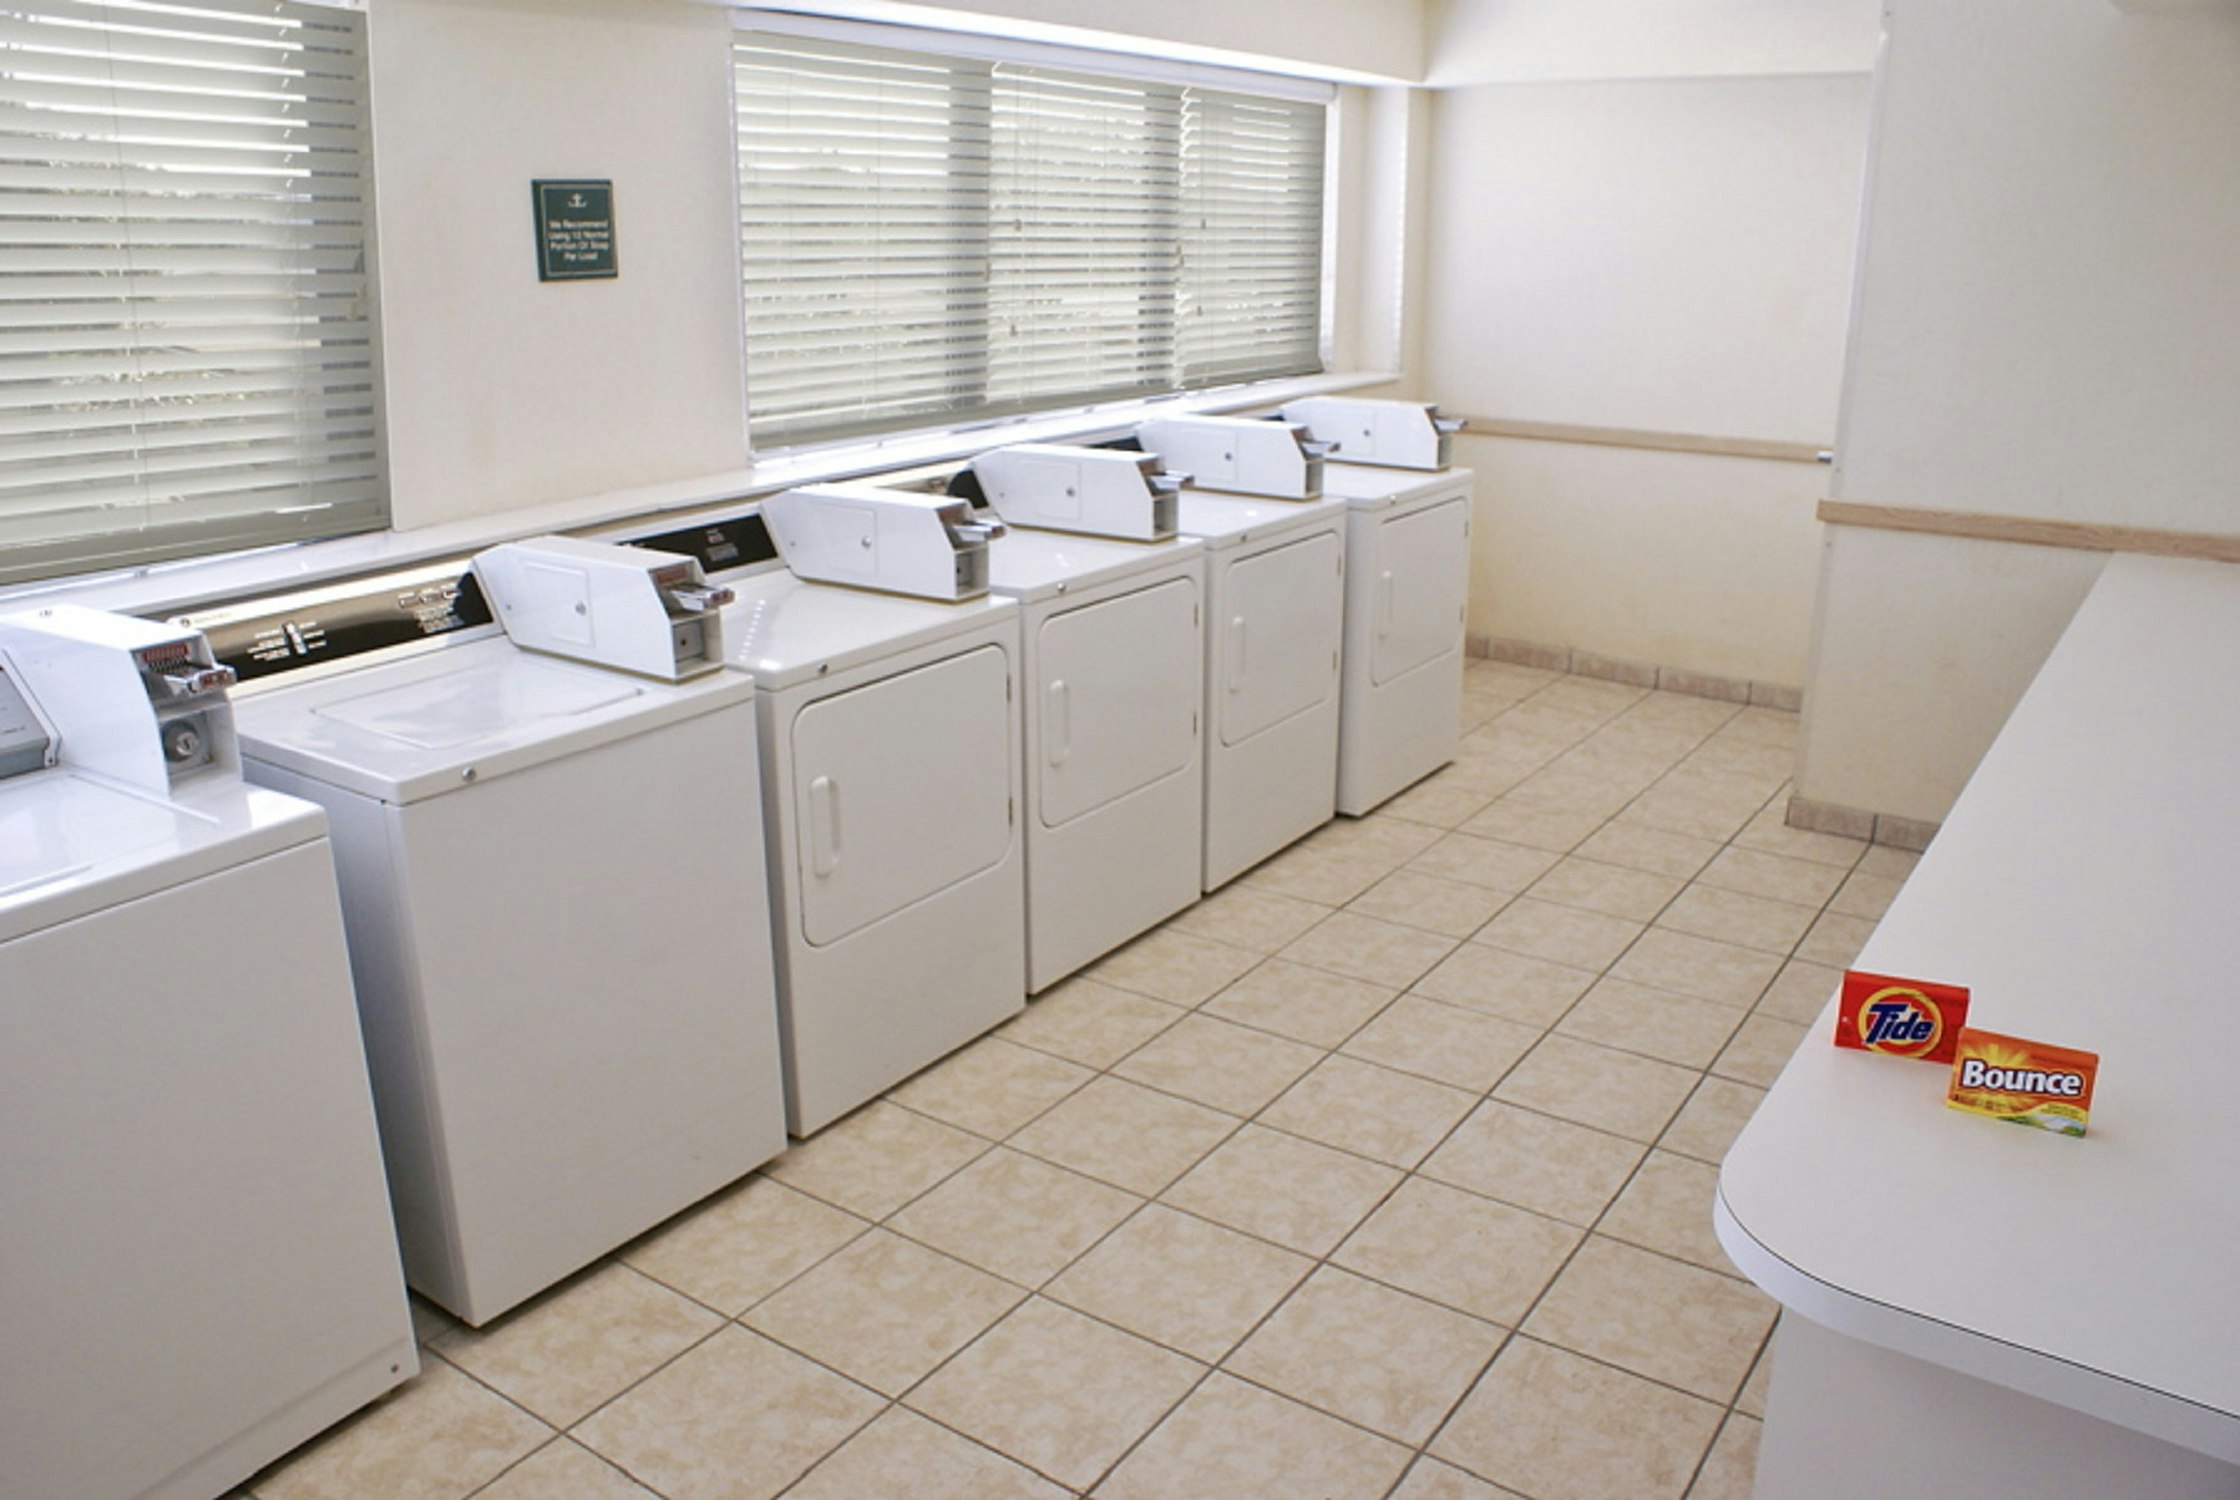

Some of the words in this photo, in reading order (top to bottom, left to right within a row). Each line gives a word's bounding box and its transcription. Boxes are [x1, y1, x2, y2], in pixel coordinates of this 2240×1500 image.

[548, 231, 571, 242] Using
[582, 230, 609, 239] Normal
[562, 219, 608, 229] Recommend
[1866, 1002, 1934, 1045] Tide
[1962, 1060, 2082, 1096] Bounce
